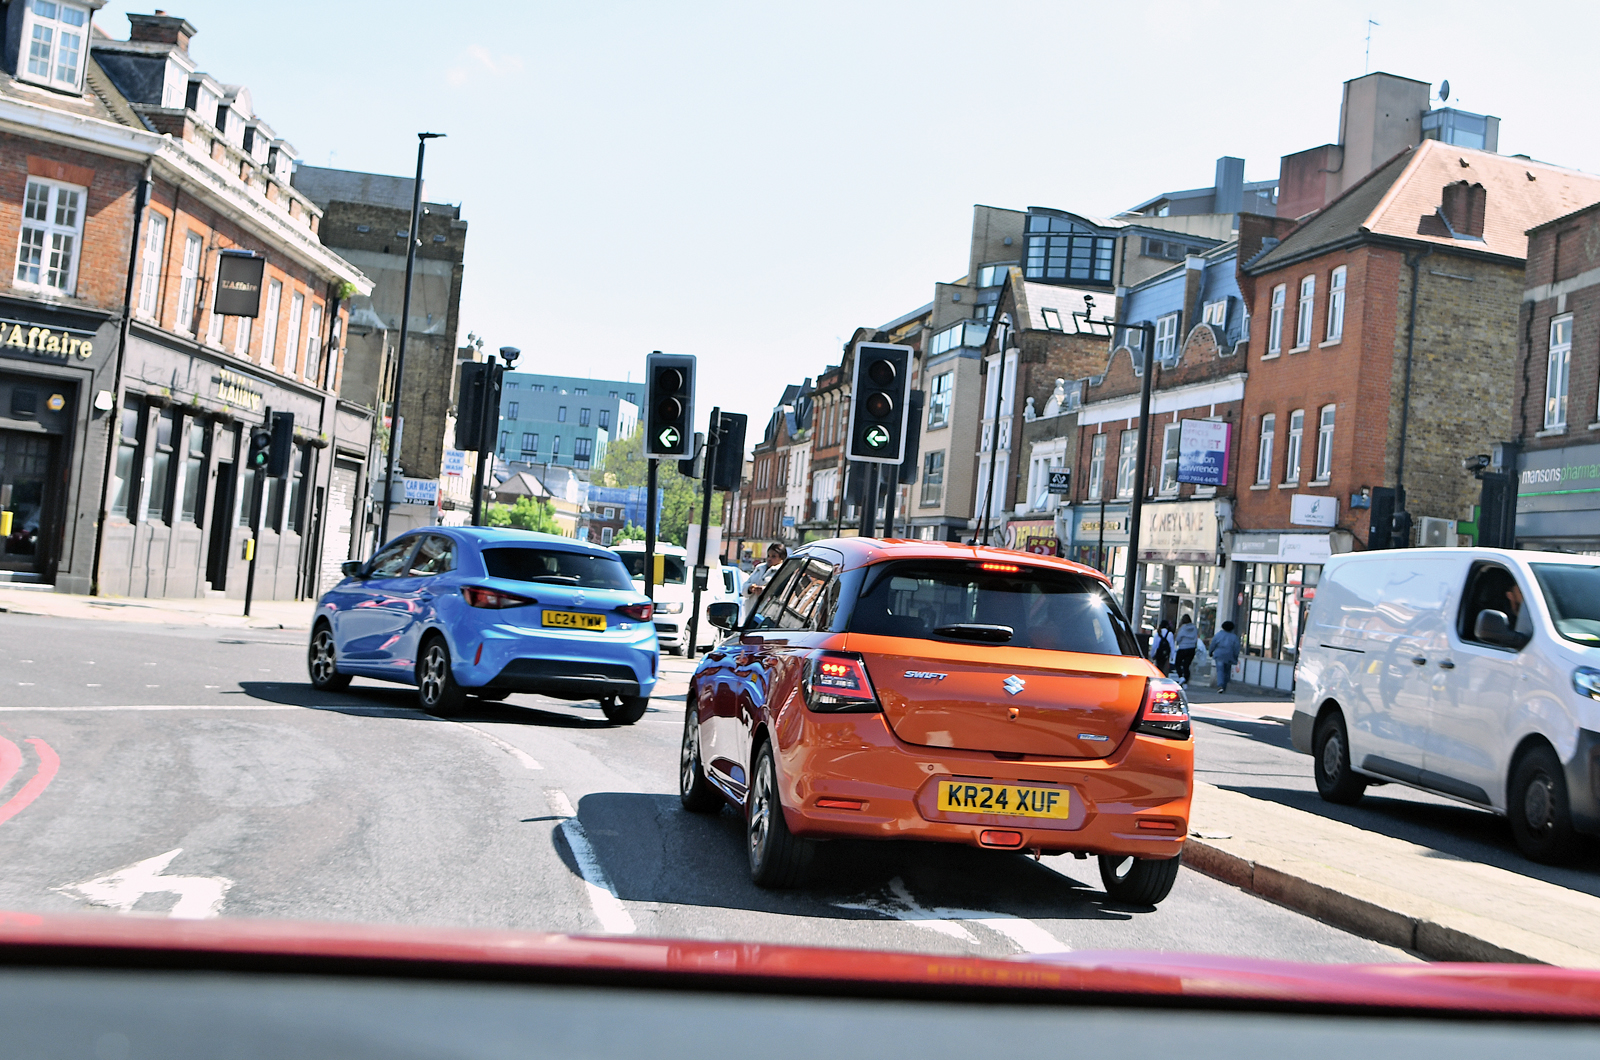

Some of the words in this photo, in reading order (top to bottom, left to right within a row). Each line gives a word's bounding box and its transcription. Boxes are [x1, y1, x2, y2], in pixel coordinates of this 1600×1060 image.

[0, 322, 94, 358] 'Affaire
[405, 480, 418, 490] CAR
[419, 481, 437, 492] WASH
[1030, 538, 1056, 548] RED
[547, 612, 577, 626] LC24
[903, 670, 948, 681] SWIFT
[948, 784, 1008, 810] KR24
[1016, 789, 1060, 813] XUF
